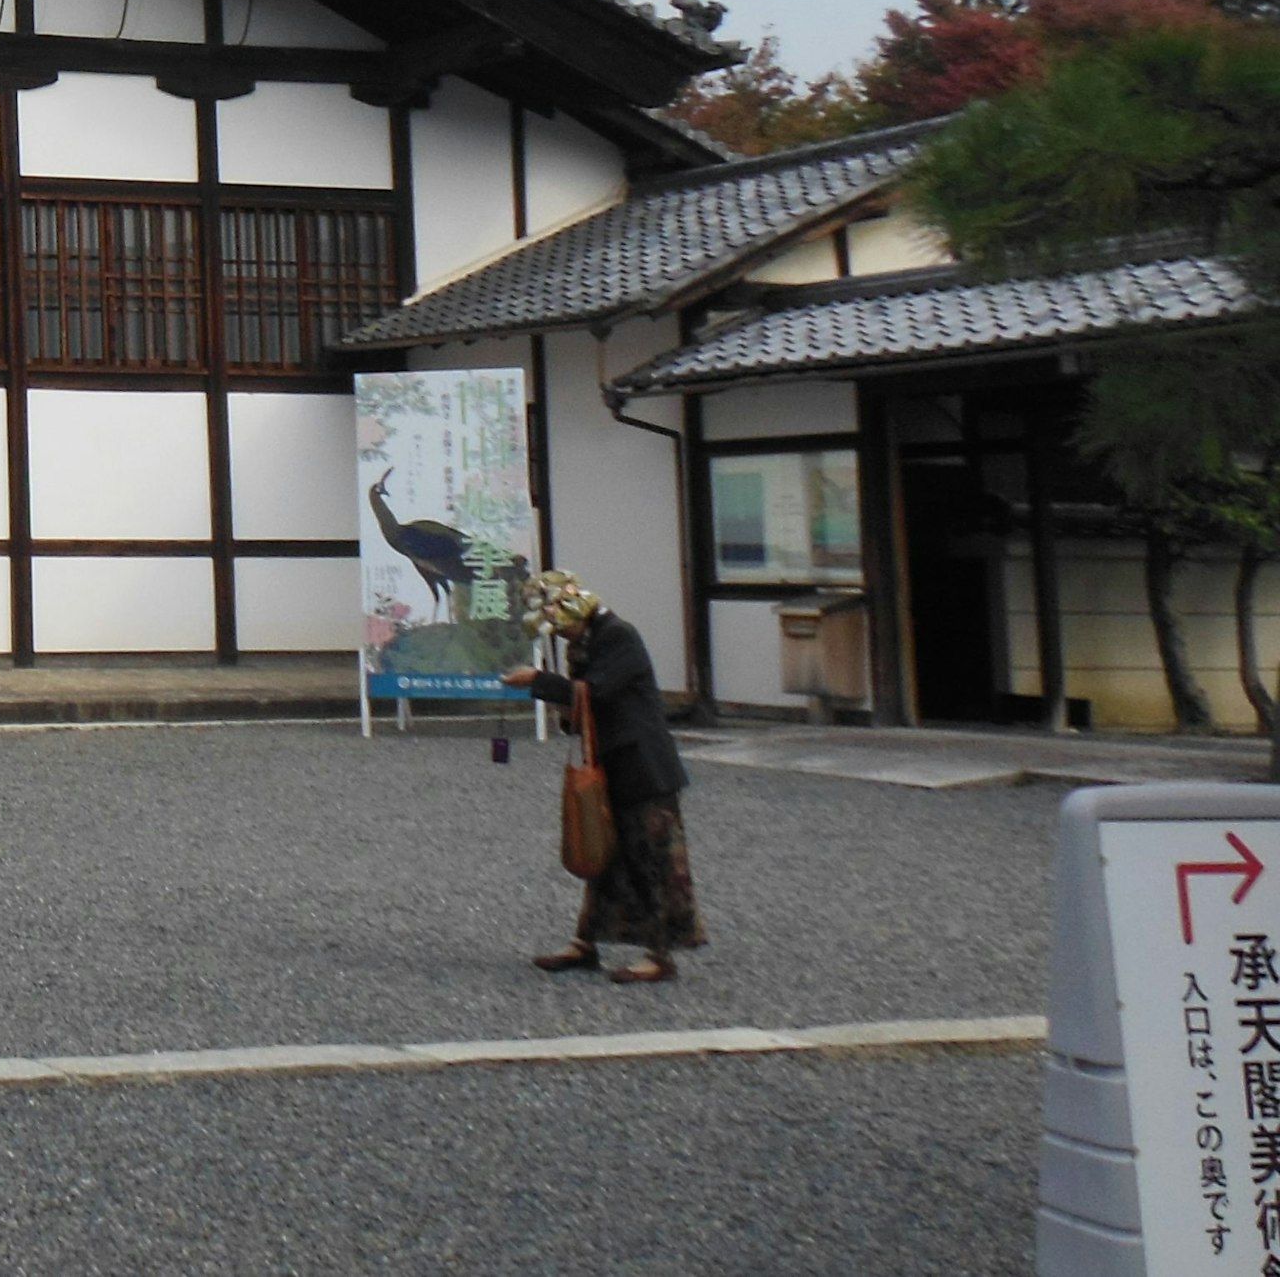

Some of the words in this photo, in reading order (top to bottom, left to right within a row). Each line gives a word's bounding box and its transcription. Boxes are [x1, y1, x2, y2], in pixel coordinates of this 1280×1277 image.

[1182, 972, 1231, 1255] 入口は、この奥です
[1229, 933, 1280, 1277] 承天閣美
